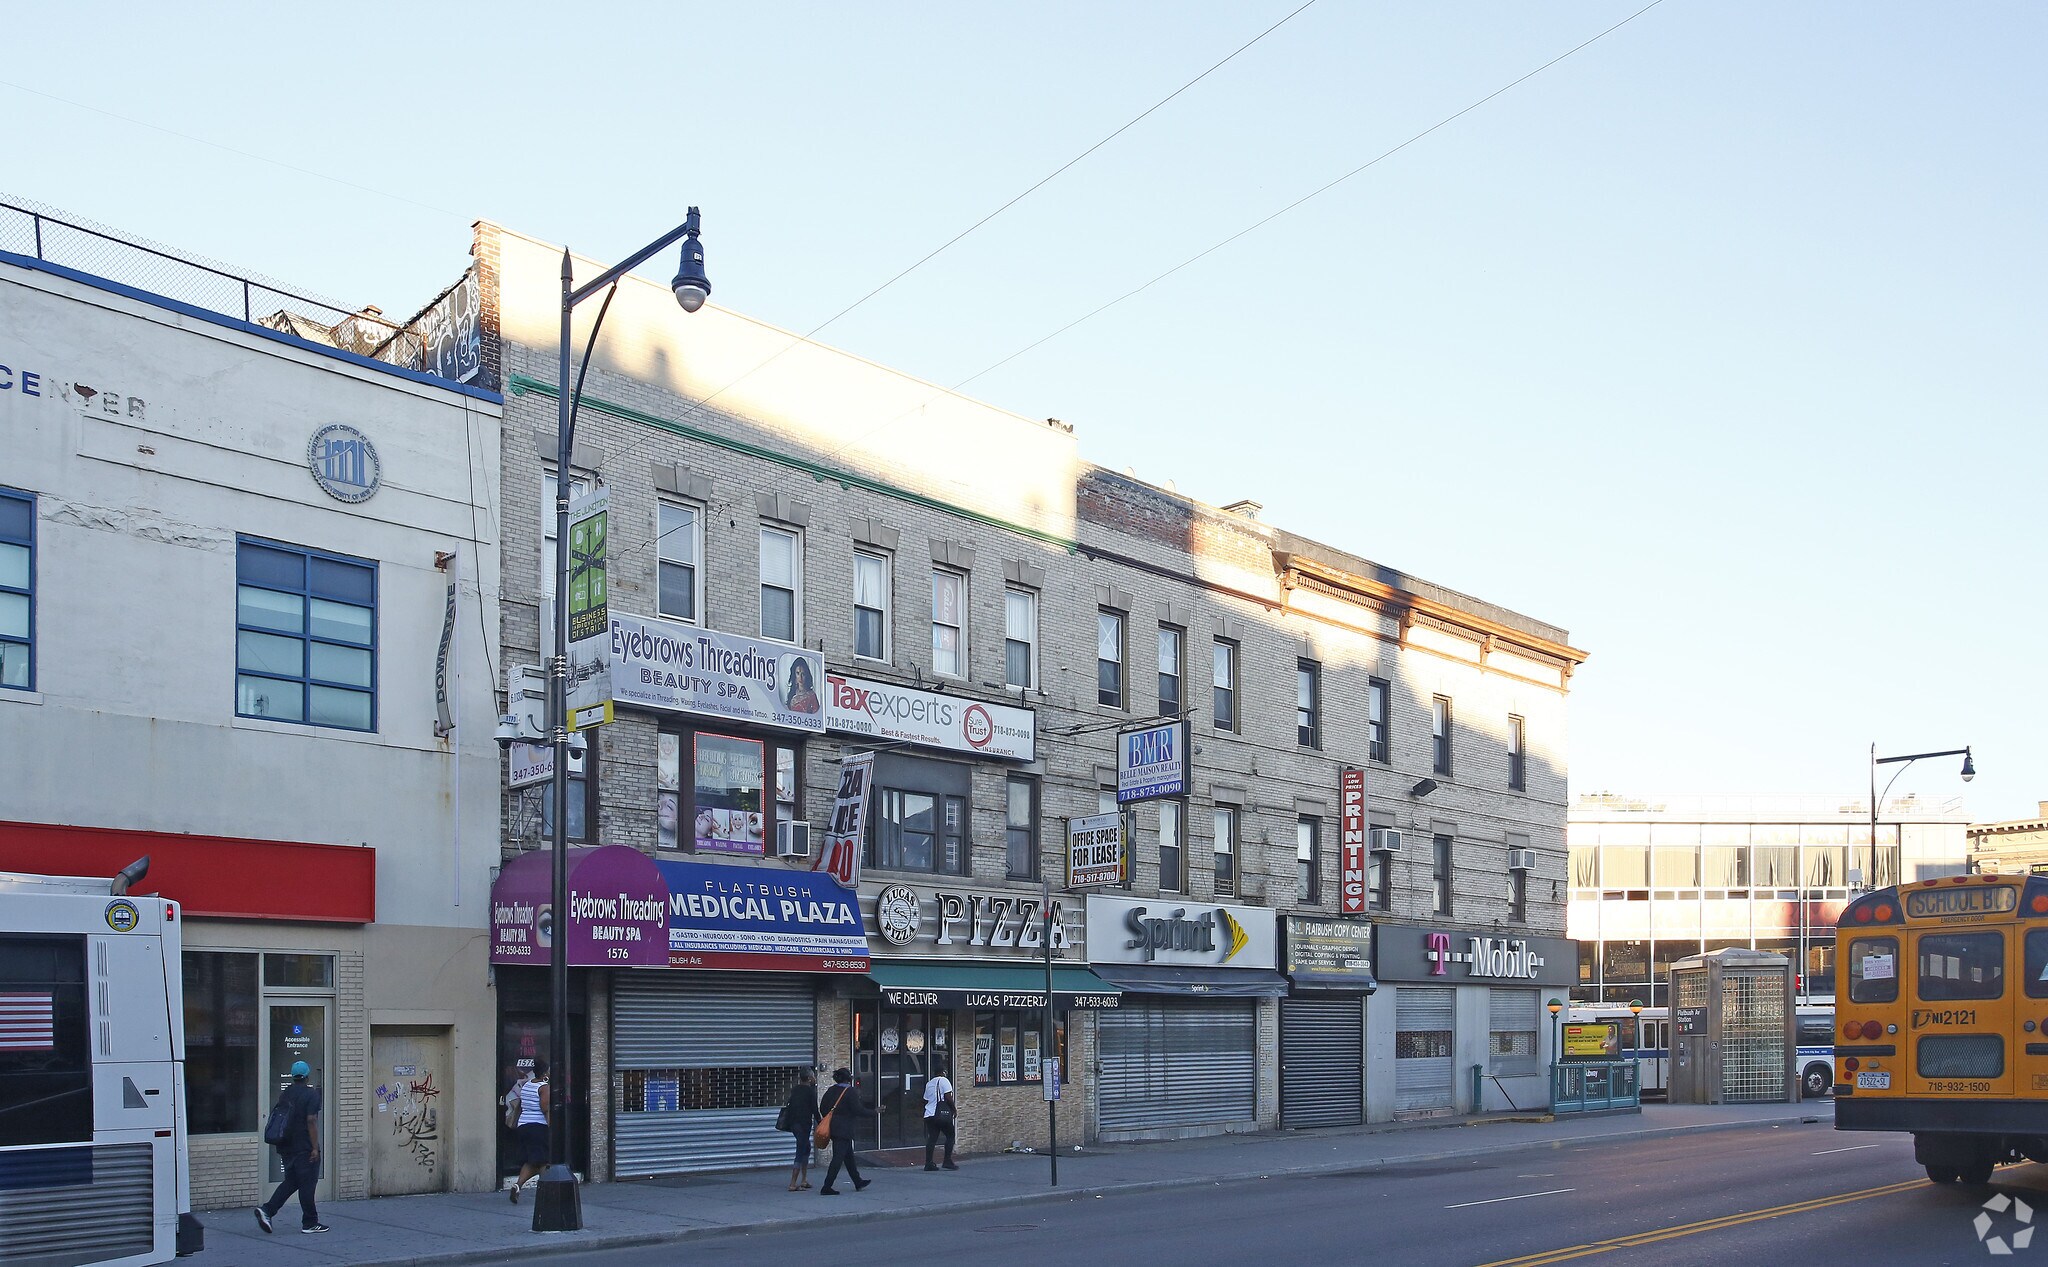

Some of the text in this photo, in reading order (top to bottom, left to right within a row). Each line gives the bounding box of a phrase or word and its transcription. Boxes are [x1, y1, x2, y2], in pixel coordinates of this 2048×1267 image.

[572, 606, 606, 626] BUSINESS
[572, 621, 606, 640] DISTRICT
[436, 582, 456, 704] DOWNSTATE
[611, 619, 777, 692] Eyebrows Threading
[640, 668, 750, 701] BEAUTY SPA
[771, 712, 822, 729] 347-350-6333
[968, 716, 983, 727] Sure
[881, 727, 894, 736] Best
[968, 724, 988, 737] Trust
[1131, 730, 1173, 768] BMR
[1120, 760, 1182, 780] BELLE MAISON REALTY
[1120, 782, 1181, 800] 718-873-0090
[1072, 830, 1095, 848] OFFICE
[1096, 827, 1118, 845] SPACE
[1345, 791, 1363, 895] PRINTING
[1073, 844, 1117, 867] FOR LEASE
[704, 880, 812, 898] FLATBUSH
[886, 888, 916, 906] LUCAS
[570, 890, 665, 929] Eyebrows Threading
[669, 892, 857, 925] MEDICAL PLAZA
[1915, 888, 1979, 914] SCHOOL
[935, 892, 1071, 949] PIZZA
[1940, 916, 1970, 924] EMERGENCY
[500, 928, 527, 943] BEAUTY SPA
[592, 925, 642, 941] BEAUTY SPA
[702, 933, 736, 941] NEUROLOGY
[739, 934, 756, 942] SONO
[760, 935, 776, 943] ECHO
[777, 935, 812, 944] DIAGNOSTICS
[814, 937, 828, 945] PAIN
[828, 937, 864, 945] MANAGEMENT
[884, 920, 916, 941] PIZZA
[1127, 906, 1216, 962] Sprint
[1305, 922, 1333, 937] FLATBUSH
[1334, 924, 1350, 938] COPY
[1350, 926, 1371, 939] CENTER
[495, 945, 531, 956] 347-350-6333
[607, 948, 629, 960] 1576
[1294, 943, 1319, 951] JOURNALS
[888, 992, 939, 1006] WE DELIVER
[966, 993, 1000, 1007] LUCAS
[1074, 996, 1119, 1008] 347-533-6033
[976, 1052, 987, 1068] PIE
[1001, 1070, 1016, 1080] $3.50
[1928, 1081, 1990, 1093] 718-932-1500
